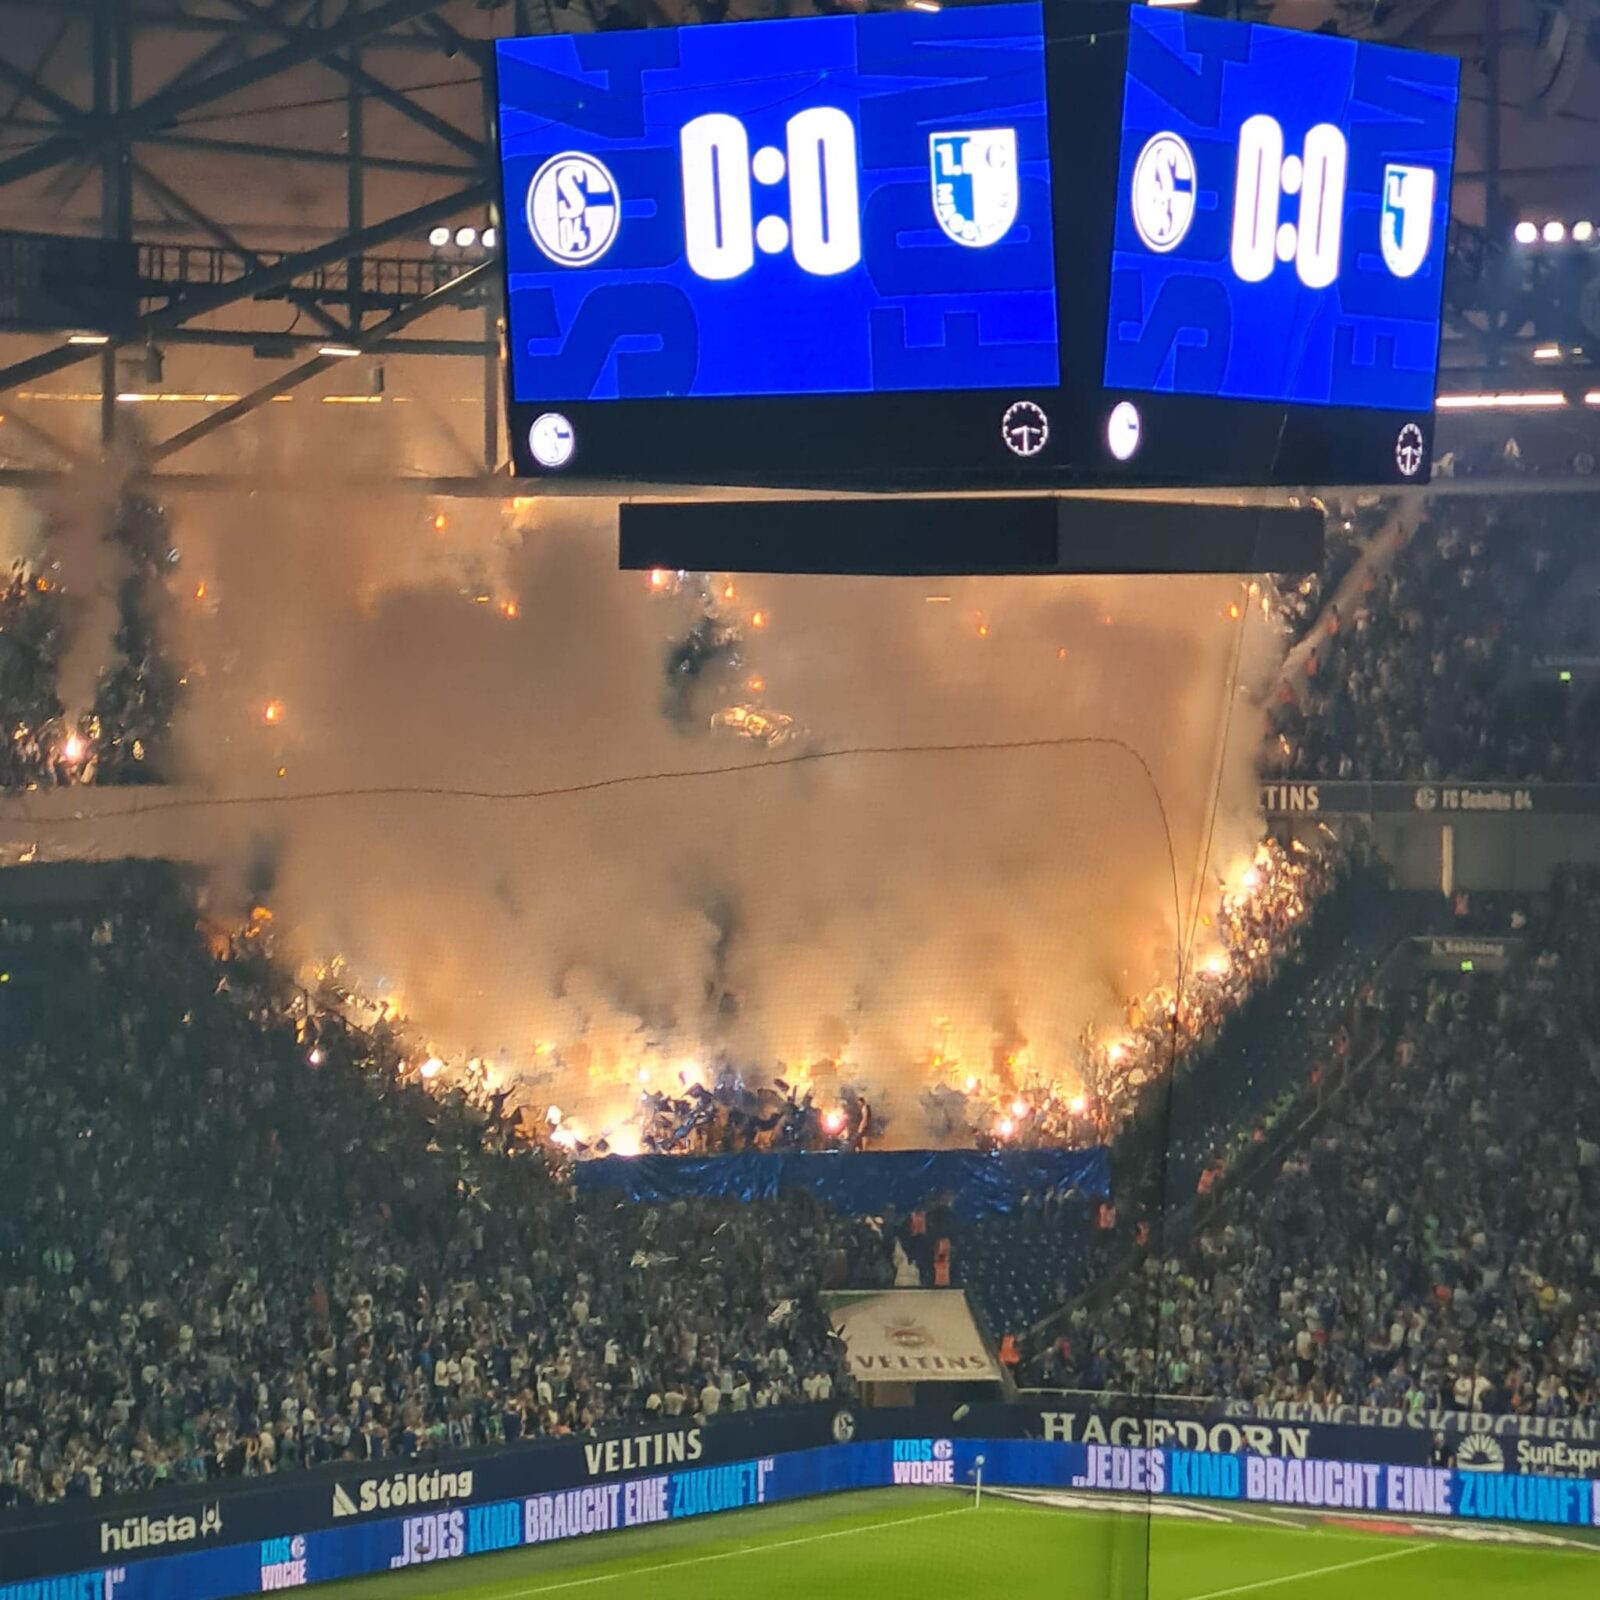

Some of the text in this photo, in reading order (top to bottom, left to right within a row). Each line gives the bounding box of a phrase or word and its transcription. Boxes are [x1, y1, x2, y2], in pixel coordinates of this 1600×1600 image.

[680, 107, 861, 279] 0:0
[1231, 115, 1347, 288] 0:0
[1259, 785, 1319, 810] TINS
[584, 1429, 703, 1475] VELTINS
[893, 1439, 932, 1461] KIDS
[360, 1469, 473, 1512] Stölting
[893, 1460, 954, 1484] WOCHE
[1171, 1452, 1240, 1498] KIND
[1246, 1455, 1381, 1509] BRAUCHT
[1387, 1464, 1452, 1514] EINE
[101, 1514, 196, 1553] hülsta
[468, 1500, 521, 1554] KIND
[525, 1482, 620, 1544] BRAUCHT
[625, 1476, 669, 1526] EINE
[261, 1536, 291, 1566] KIDS
[261, 1559, 307, 1591] WOCHE
